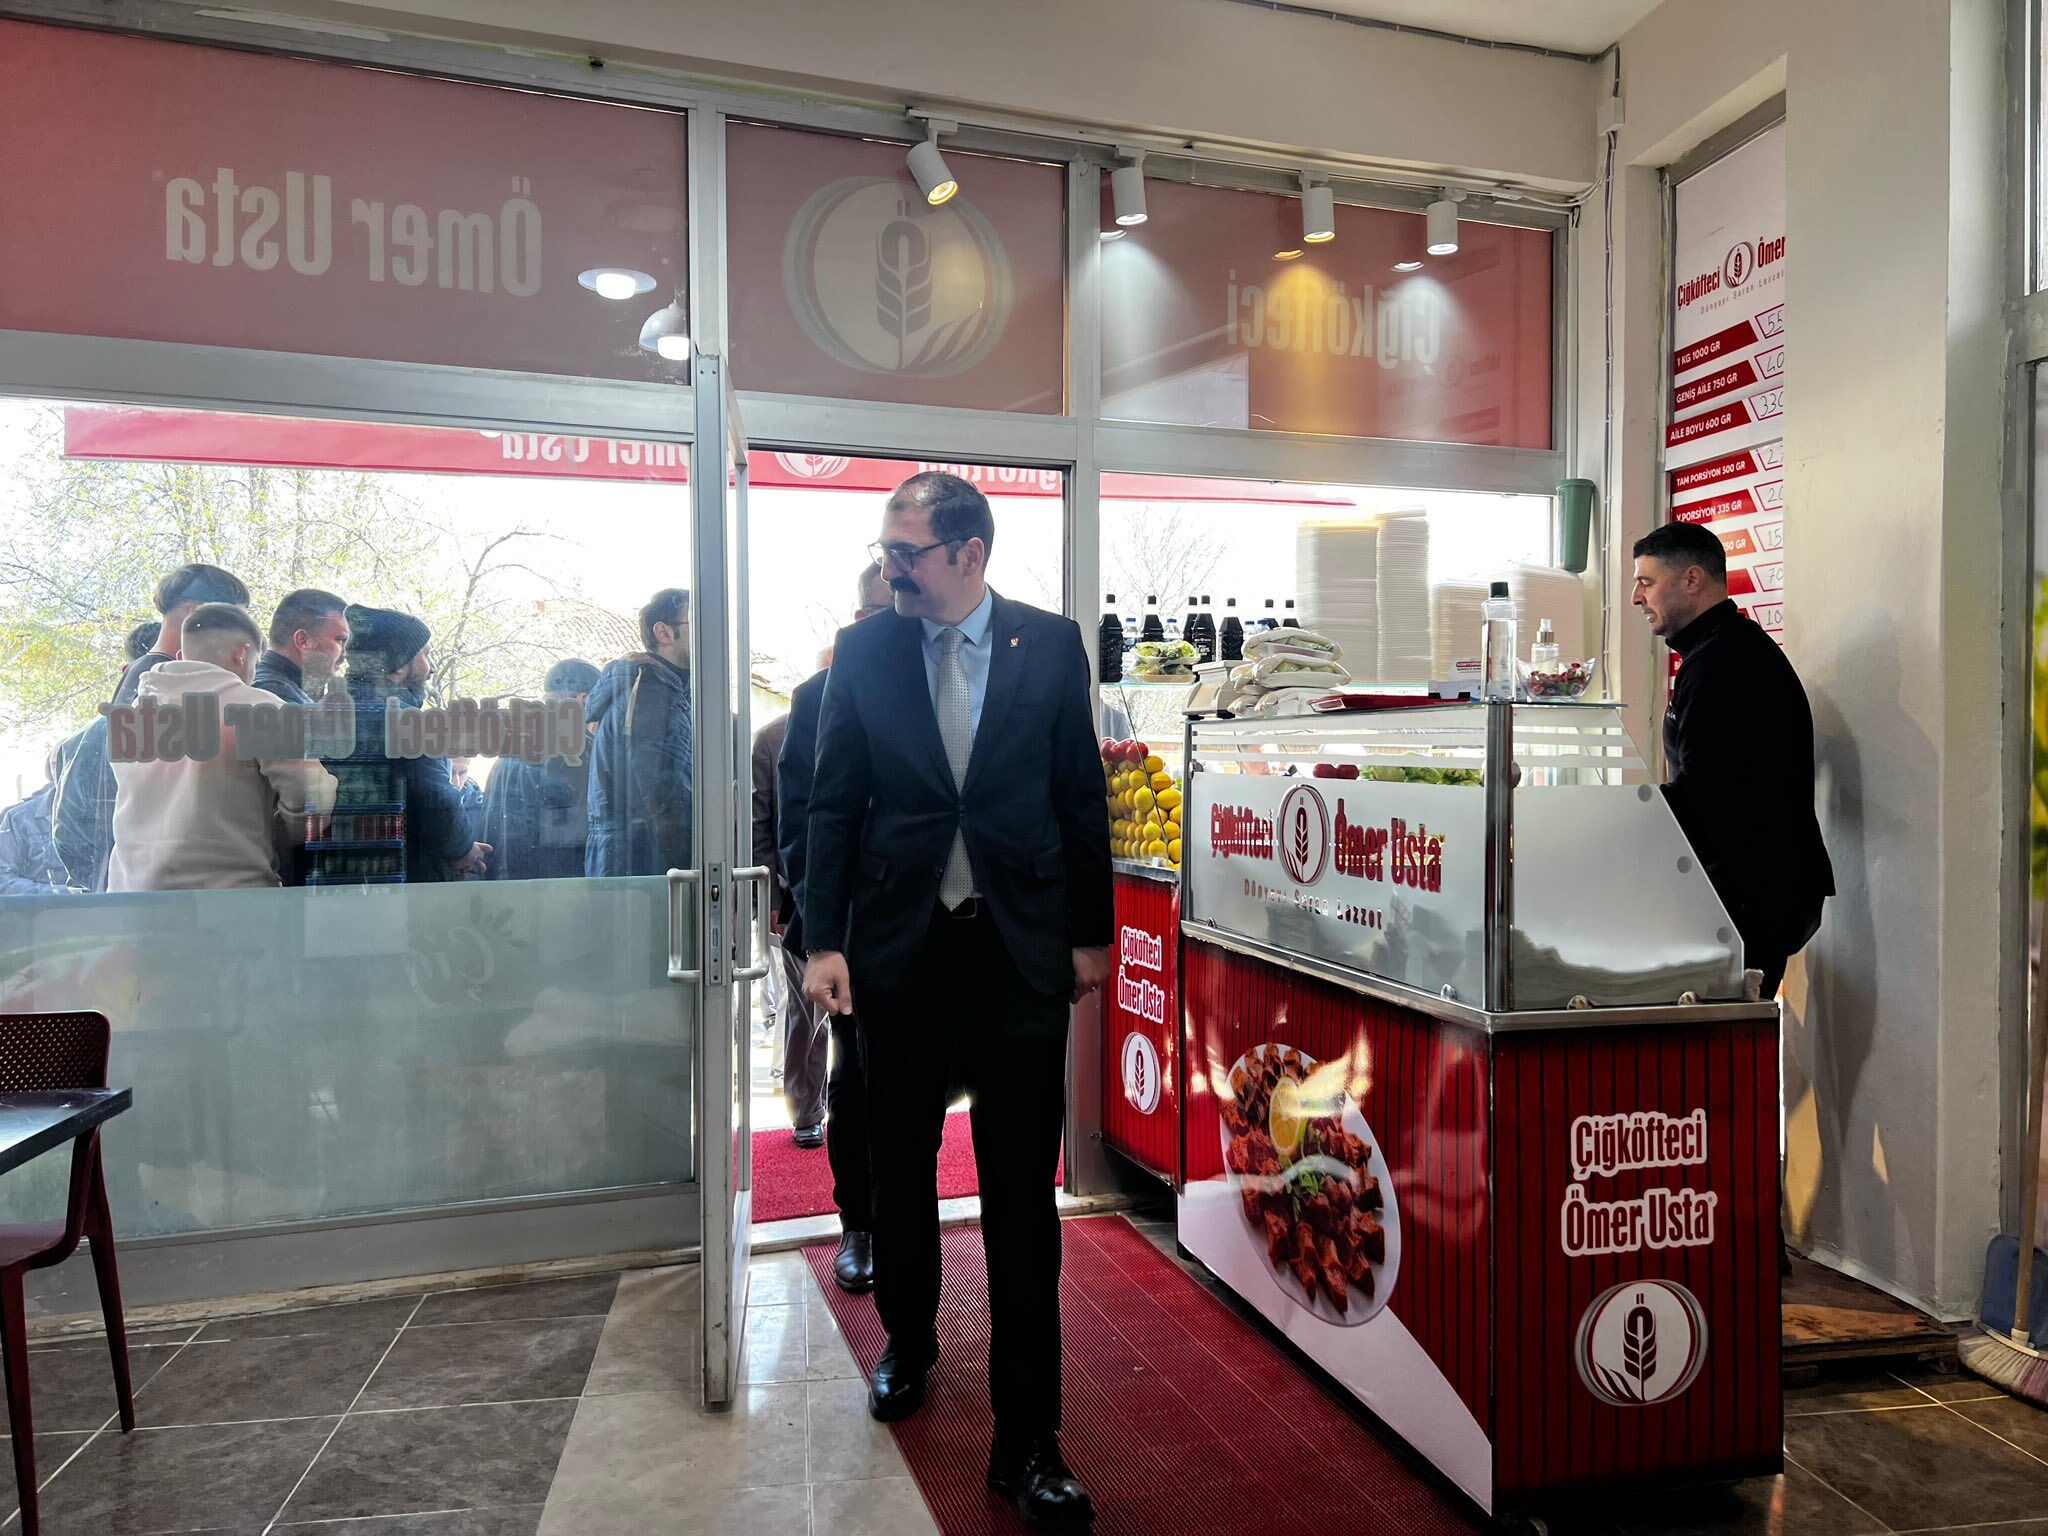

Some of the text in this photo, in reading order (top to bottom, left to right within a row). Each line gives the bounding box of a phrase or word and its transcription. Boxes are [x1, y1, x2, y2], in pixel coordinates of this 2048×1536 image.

[1677, 236, 1785, 312] Çiğköfteci Ömer
[1676, 341, 1720, 367] 1 KG 1000 GR
[1676, 372, 1738, 404] GENİŞ AİLE 750 GR
[1670, 413, 1731, 441] AİLE BOYU 600 GR
[1676, 460, 1746, 487] TAM PORSİYON 500 GR
[1717, 502, 1730, 513] 335
[1731, 499, 1742, 511] GR
[1735, 538, 1746, 549] GR
[1391, 816, 1443, 893] Usta
[1121, 926, 1162, 971] Çiğköfteci
[1118, 965, 1164, 1023] Ömer Usta
[1573, 1110, 1705, 1178] Çiğköfteci
[1564, 1187, 1712, 1252] Ömer Usta
